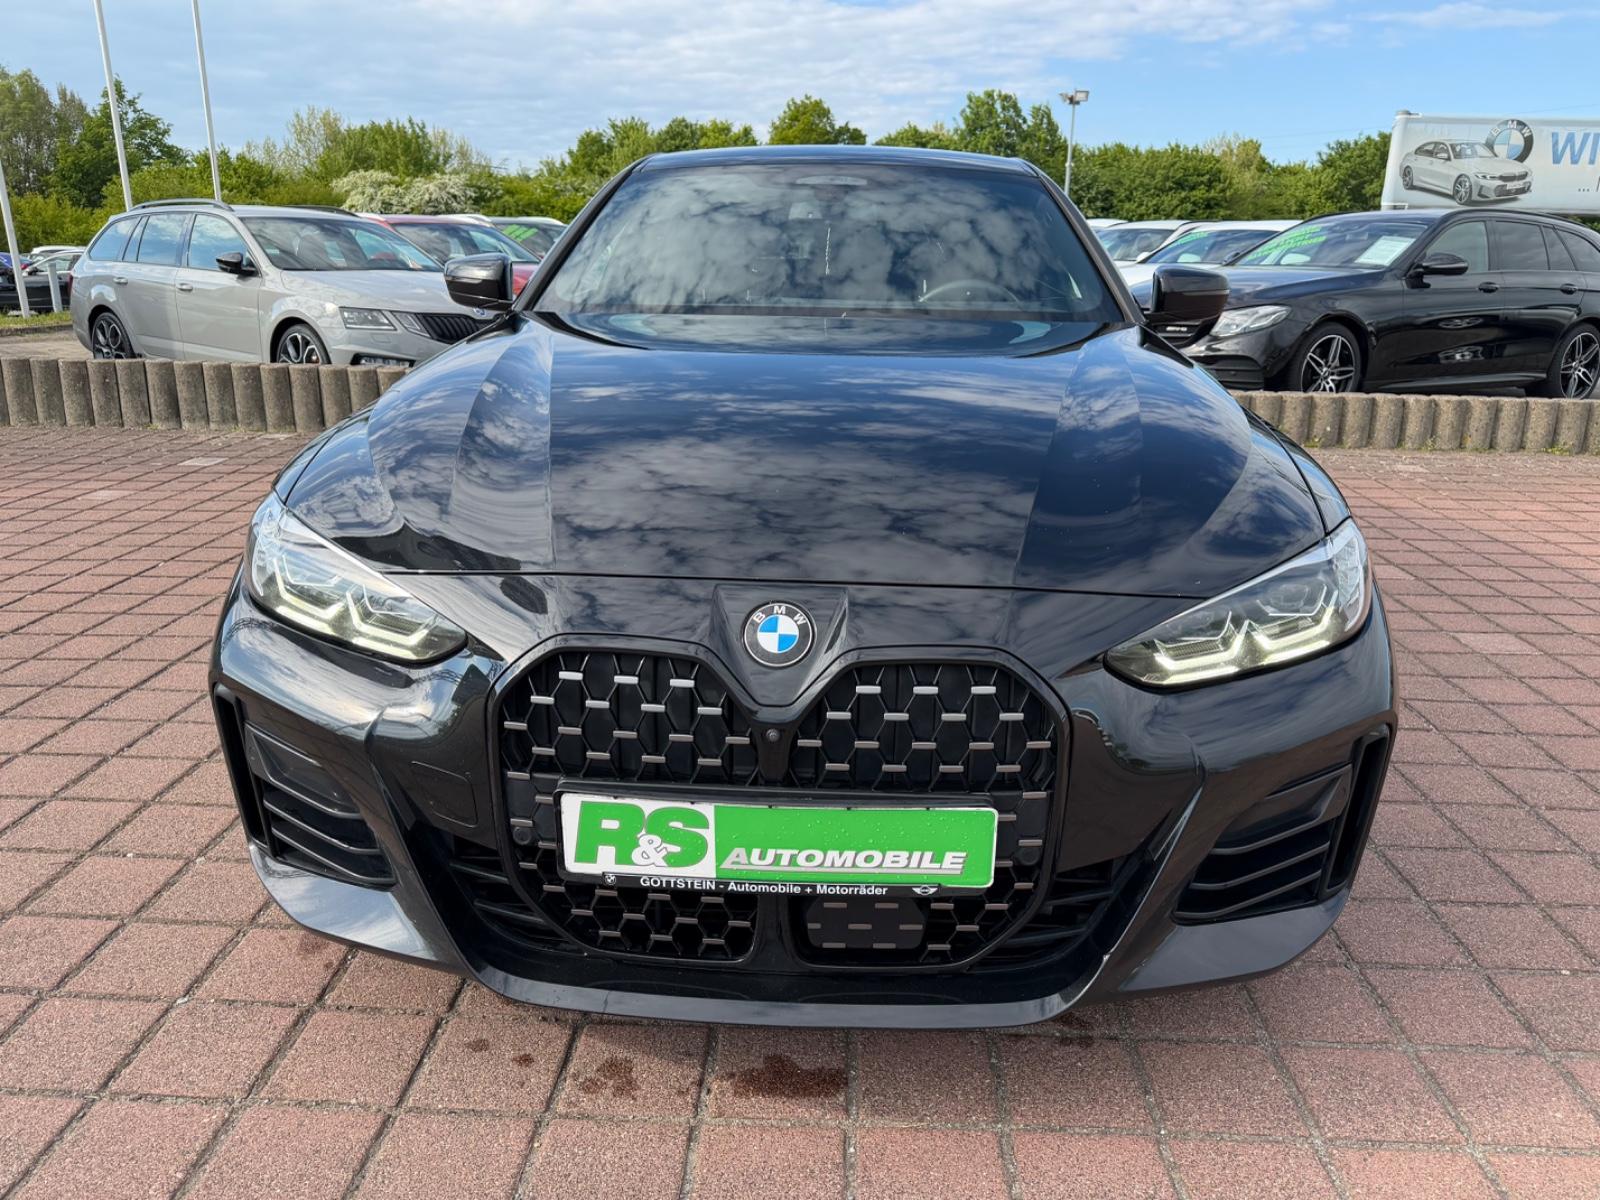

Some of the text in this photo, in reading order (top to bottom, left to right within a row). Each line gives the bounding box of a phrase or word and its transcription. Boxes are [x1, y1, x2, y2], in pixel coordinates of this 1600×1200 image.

[1491, 120, 1532, 137] BMW
[753, 605, 806, 625] BMW
[574, 800, 967, 870] R&S AUTOMOBILE
[640, 876, 716, 890] GOTTSTEIN
[727, 881, 801, 894] Automobile
[815, 884, 889, 896] Motorräder
